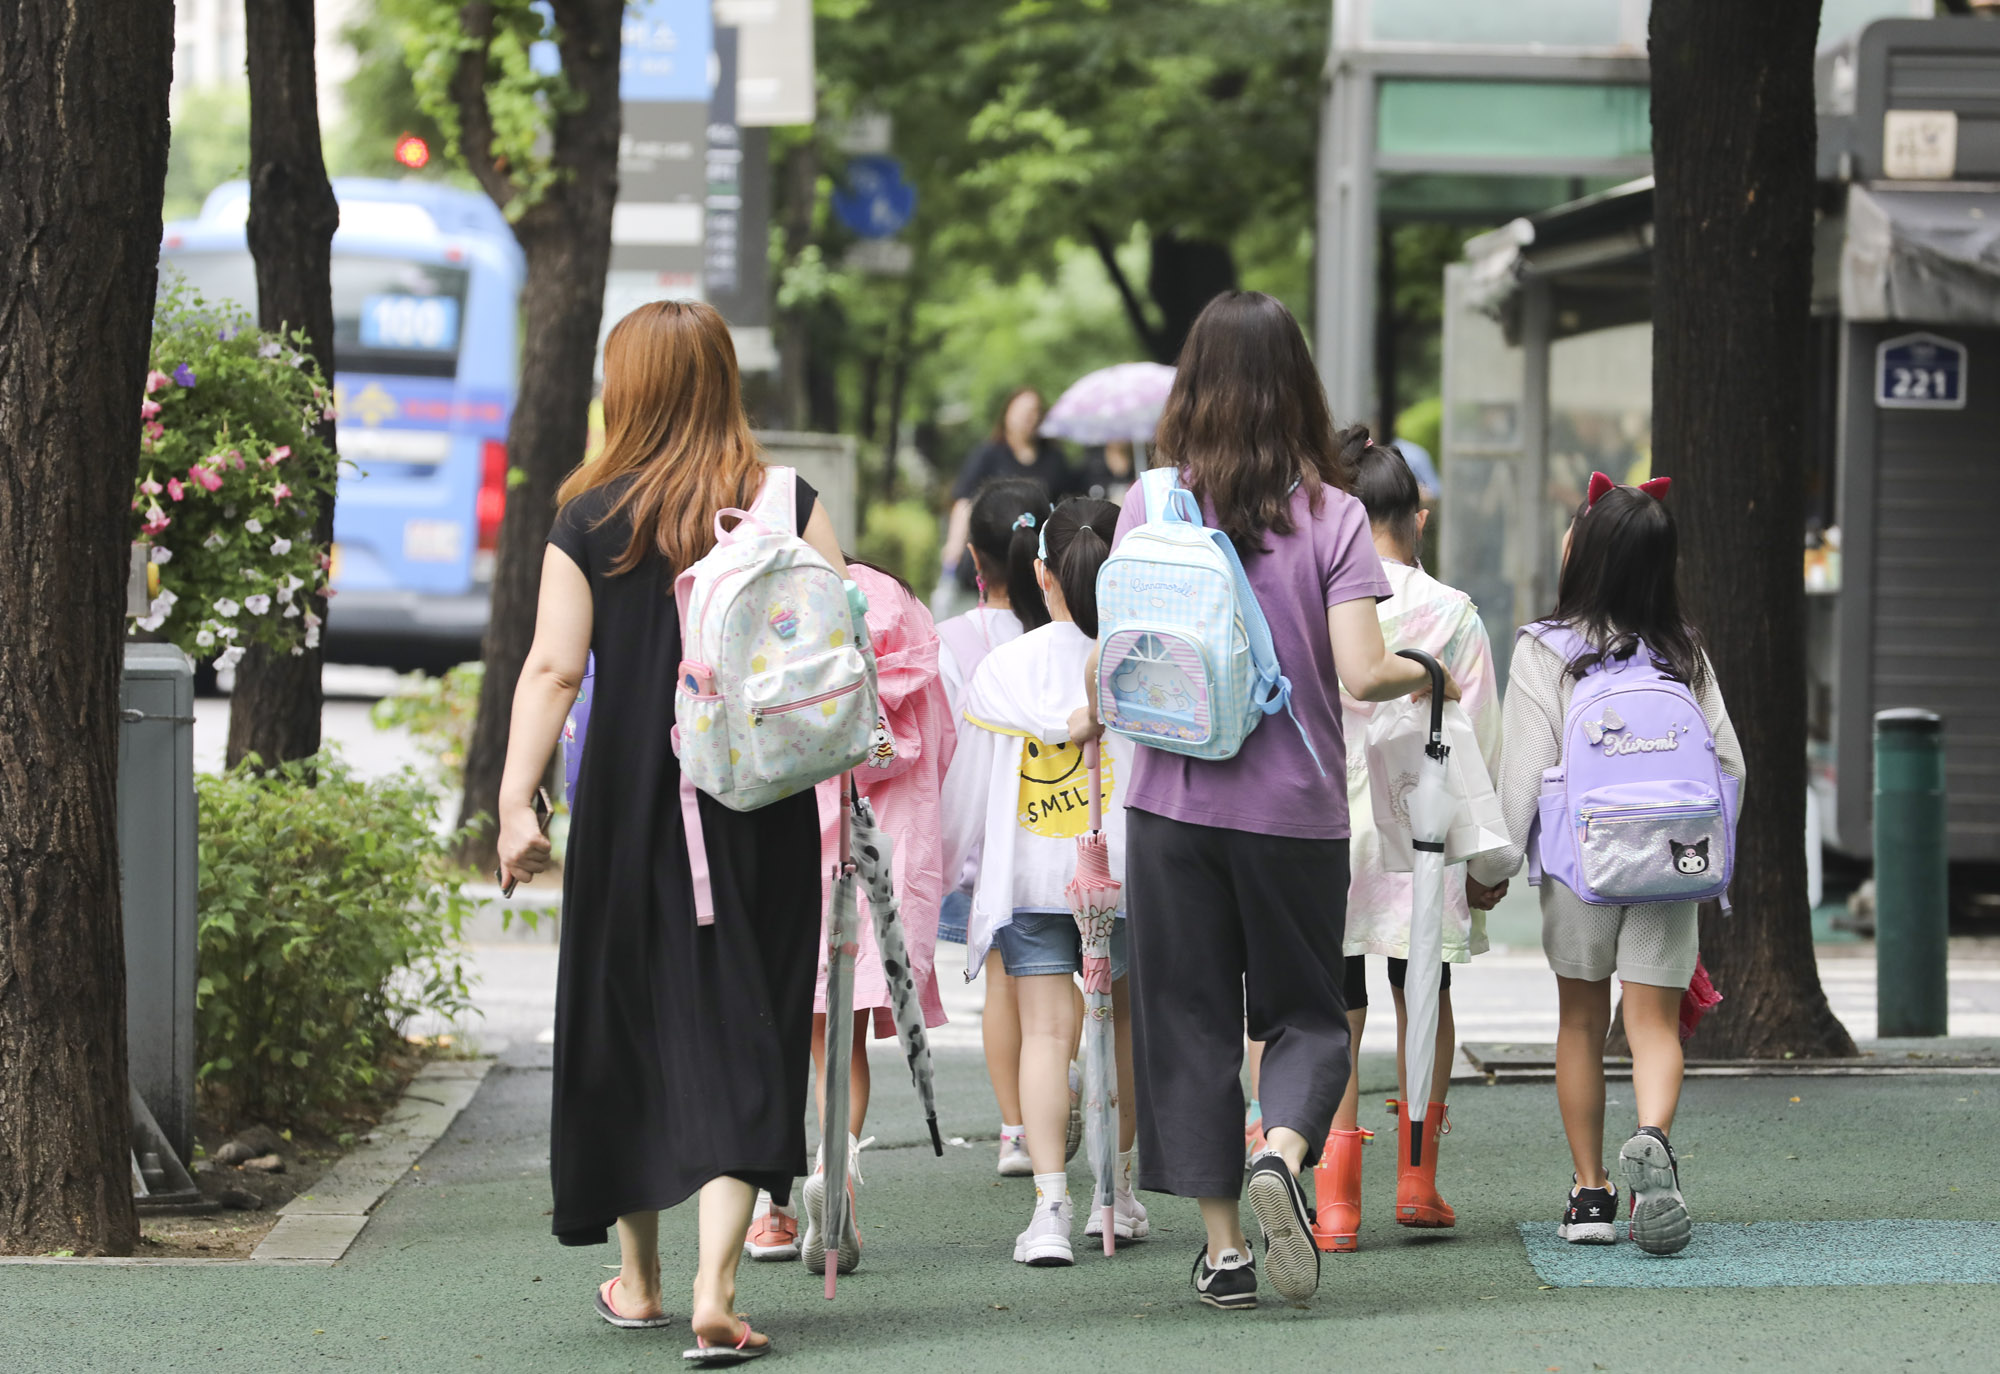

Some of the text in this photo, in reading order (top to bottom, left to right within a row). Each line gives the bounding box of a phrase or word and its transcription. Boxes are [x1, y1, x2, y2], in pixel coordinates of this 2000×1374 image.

[1892, 367, 1946, 398] 221
[1602, 730, 1679, 757] Kuromi
[1027, 786, 1106, 823] SMIL
[1221, 1254, 1239, 1265] NIKE
